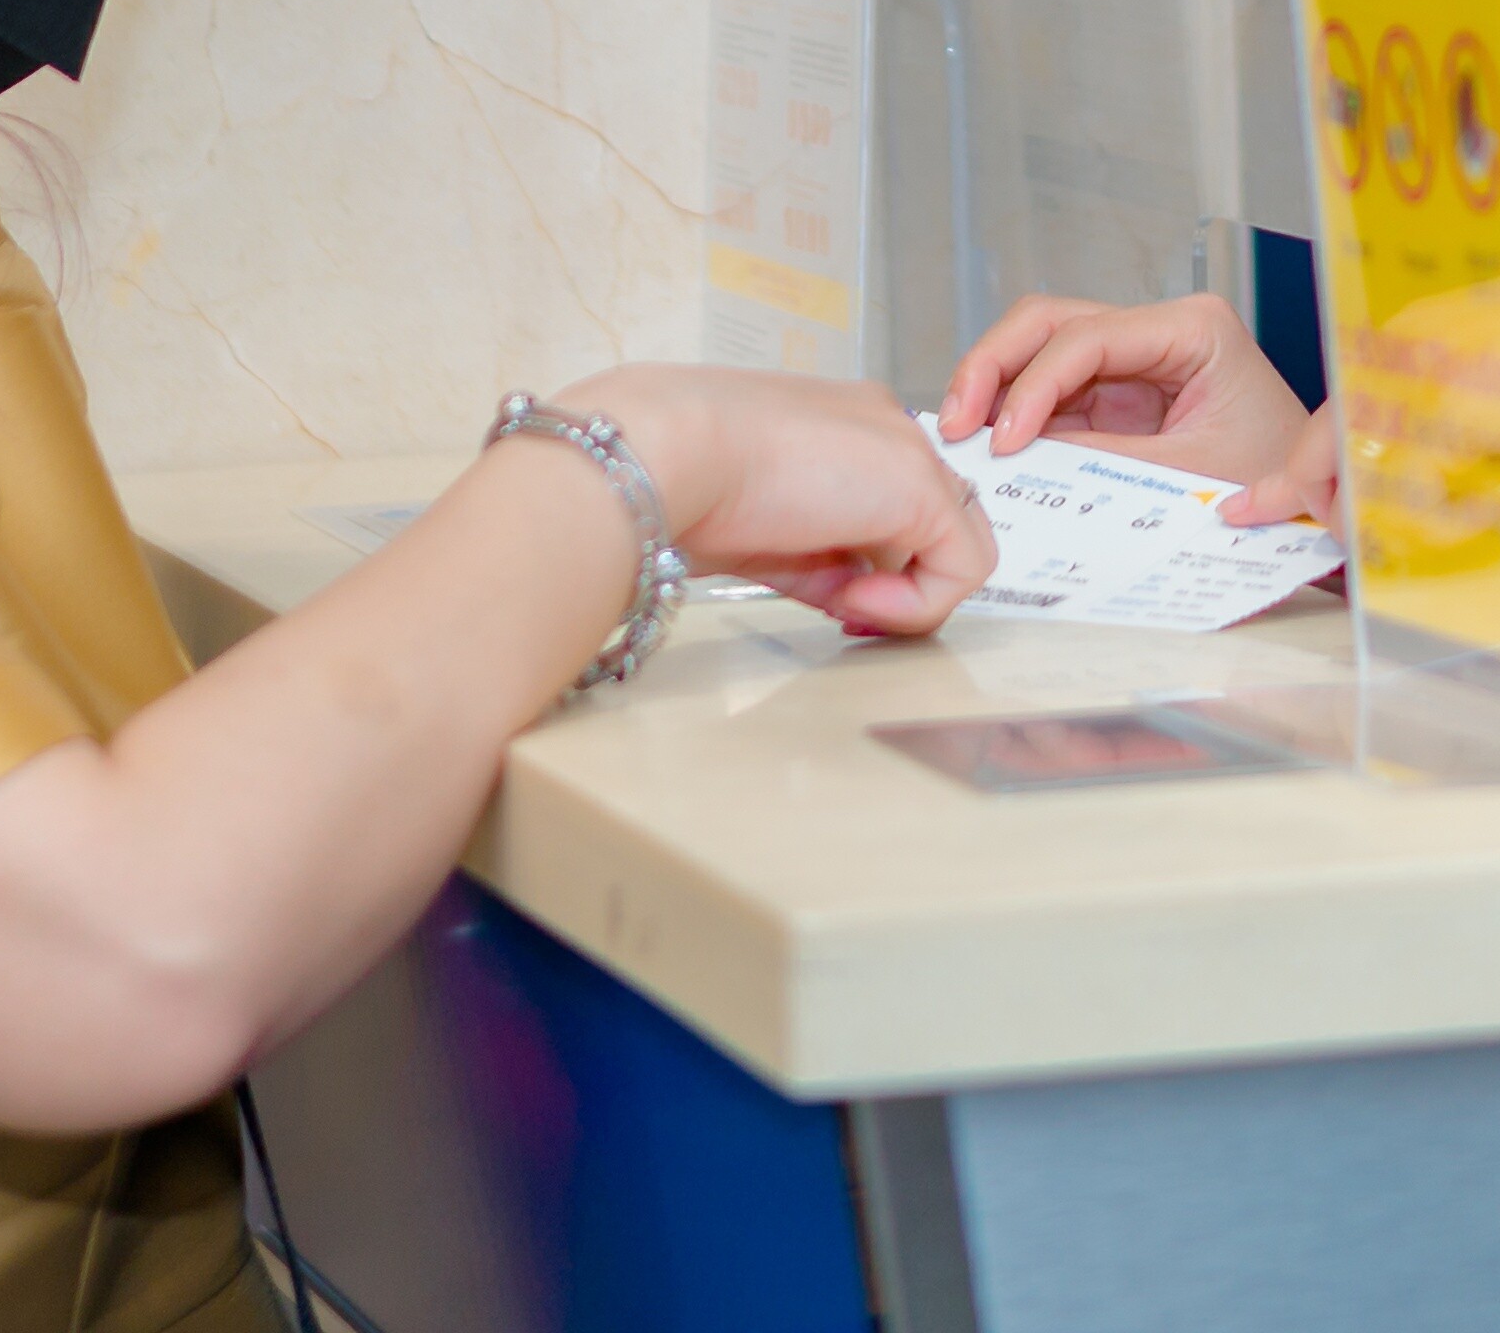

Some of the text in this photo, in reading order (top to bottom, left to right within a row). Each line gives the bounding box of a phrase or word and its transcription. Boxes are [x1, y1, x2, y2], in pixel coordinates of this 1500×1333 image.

[995, 483, 1164, 531] 06:10 9 6F
